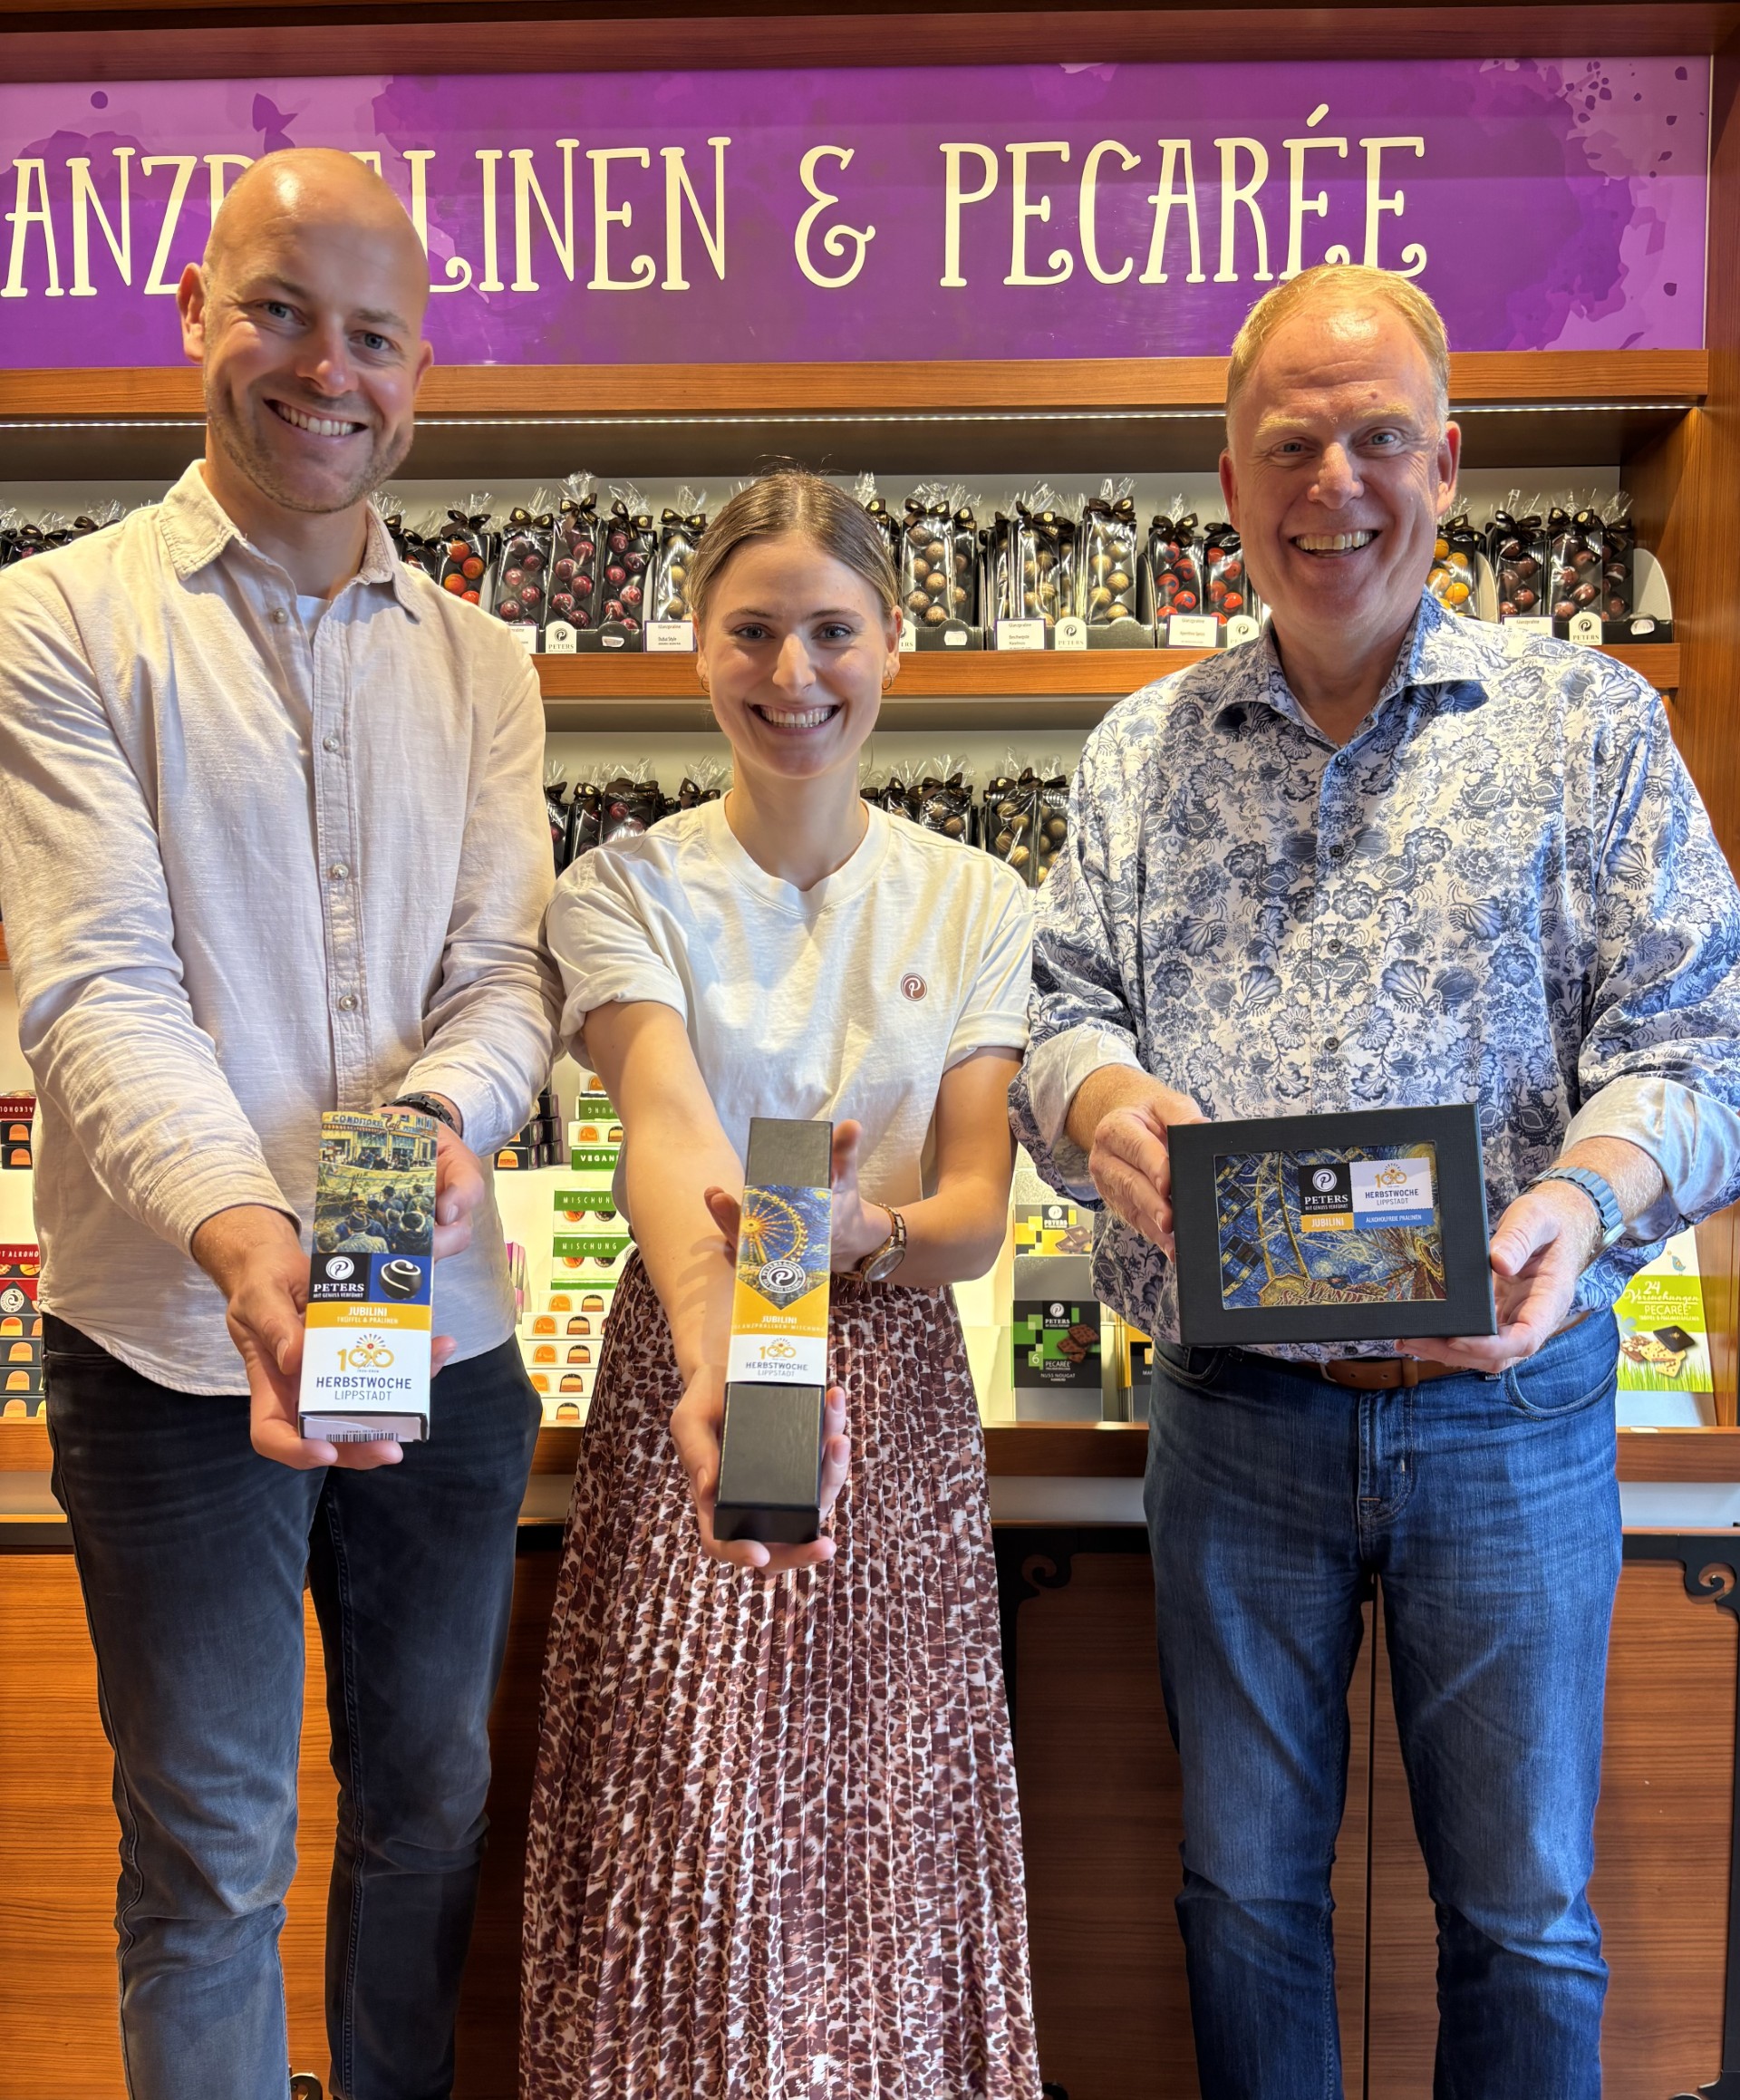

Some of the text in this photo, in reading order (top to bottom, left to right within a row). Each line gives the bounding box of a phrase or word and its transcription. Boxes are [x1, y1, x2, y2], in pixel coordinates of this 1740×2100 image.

[1, 103, 1426, 297] ANZLINEN & PECARÉE
[1365, 1188, 1419, 1199] HERBSTWOCHE
[1304, 1194, 1348, 1205] PETERS
[1377, 1197, 1409, 1205] LIPPSTADT
[1311, 1217, 1345, 1228] JUBILINI
[313, 1282, 365, 1292] PETERS
[1643, 1281, 1660, 1294] 24
[1623, 1288, 1699, 1305] Versuchungen
[348, 1306, 388, 1316] JUBILINI
[761, 1316, 798, 1324] JUBILINI
[336, 1348, 395, 1371] 100
[1031, 1353, 1039, 1364] 6
[745, 1361, 808, 1371] HERBSTWOCHE
[315, 1377, 412, 1389] HERBSTWOCHE
[334, 1390, 392, 1401] LIPPSTADT
